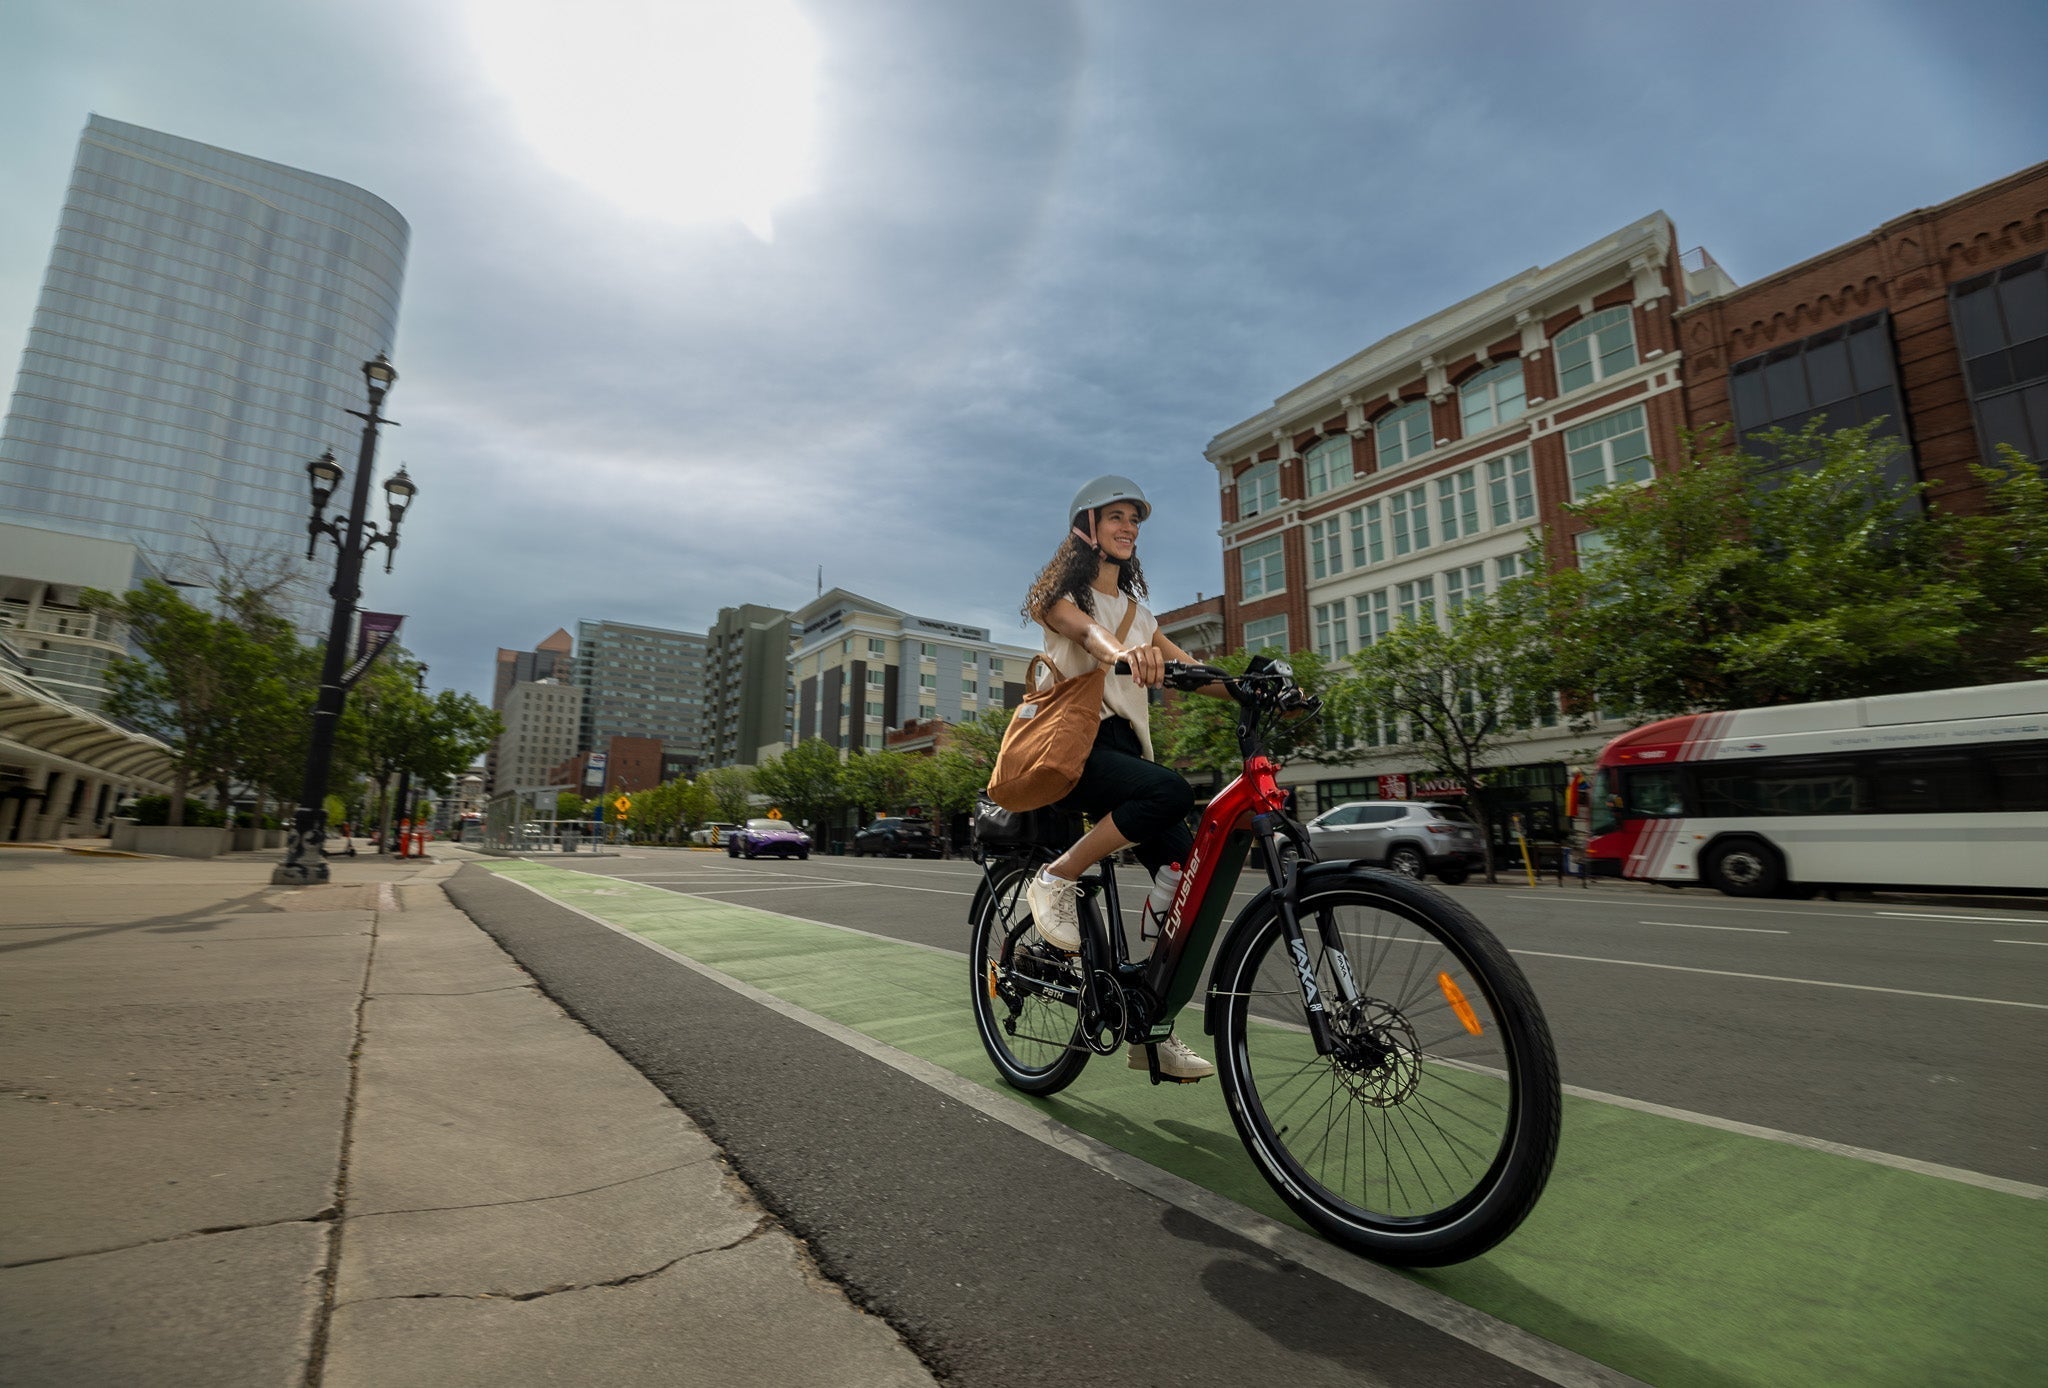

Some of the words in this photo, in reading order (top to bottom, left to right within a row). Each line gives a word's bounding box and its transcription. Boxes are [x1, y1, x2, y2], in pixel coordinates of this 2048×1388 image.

[1164, 847, 1201, 939] Cyrusher
[1290, 938, 1318, 1004] VAXA
[1309, 1003, 1323, 1012] 32
